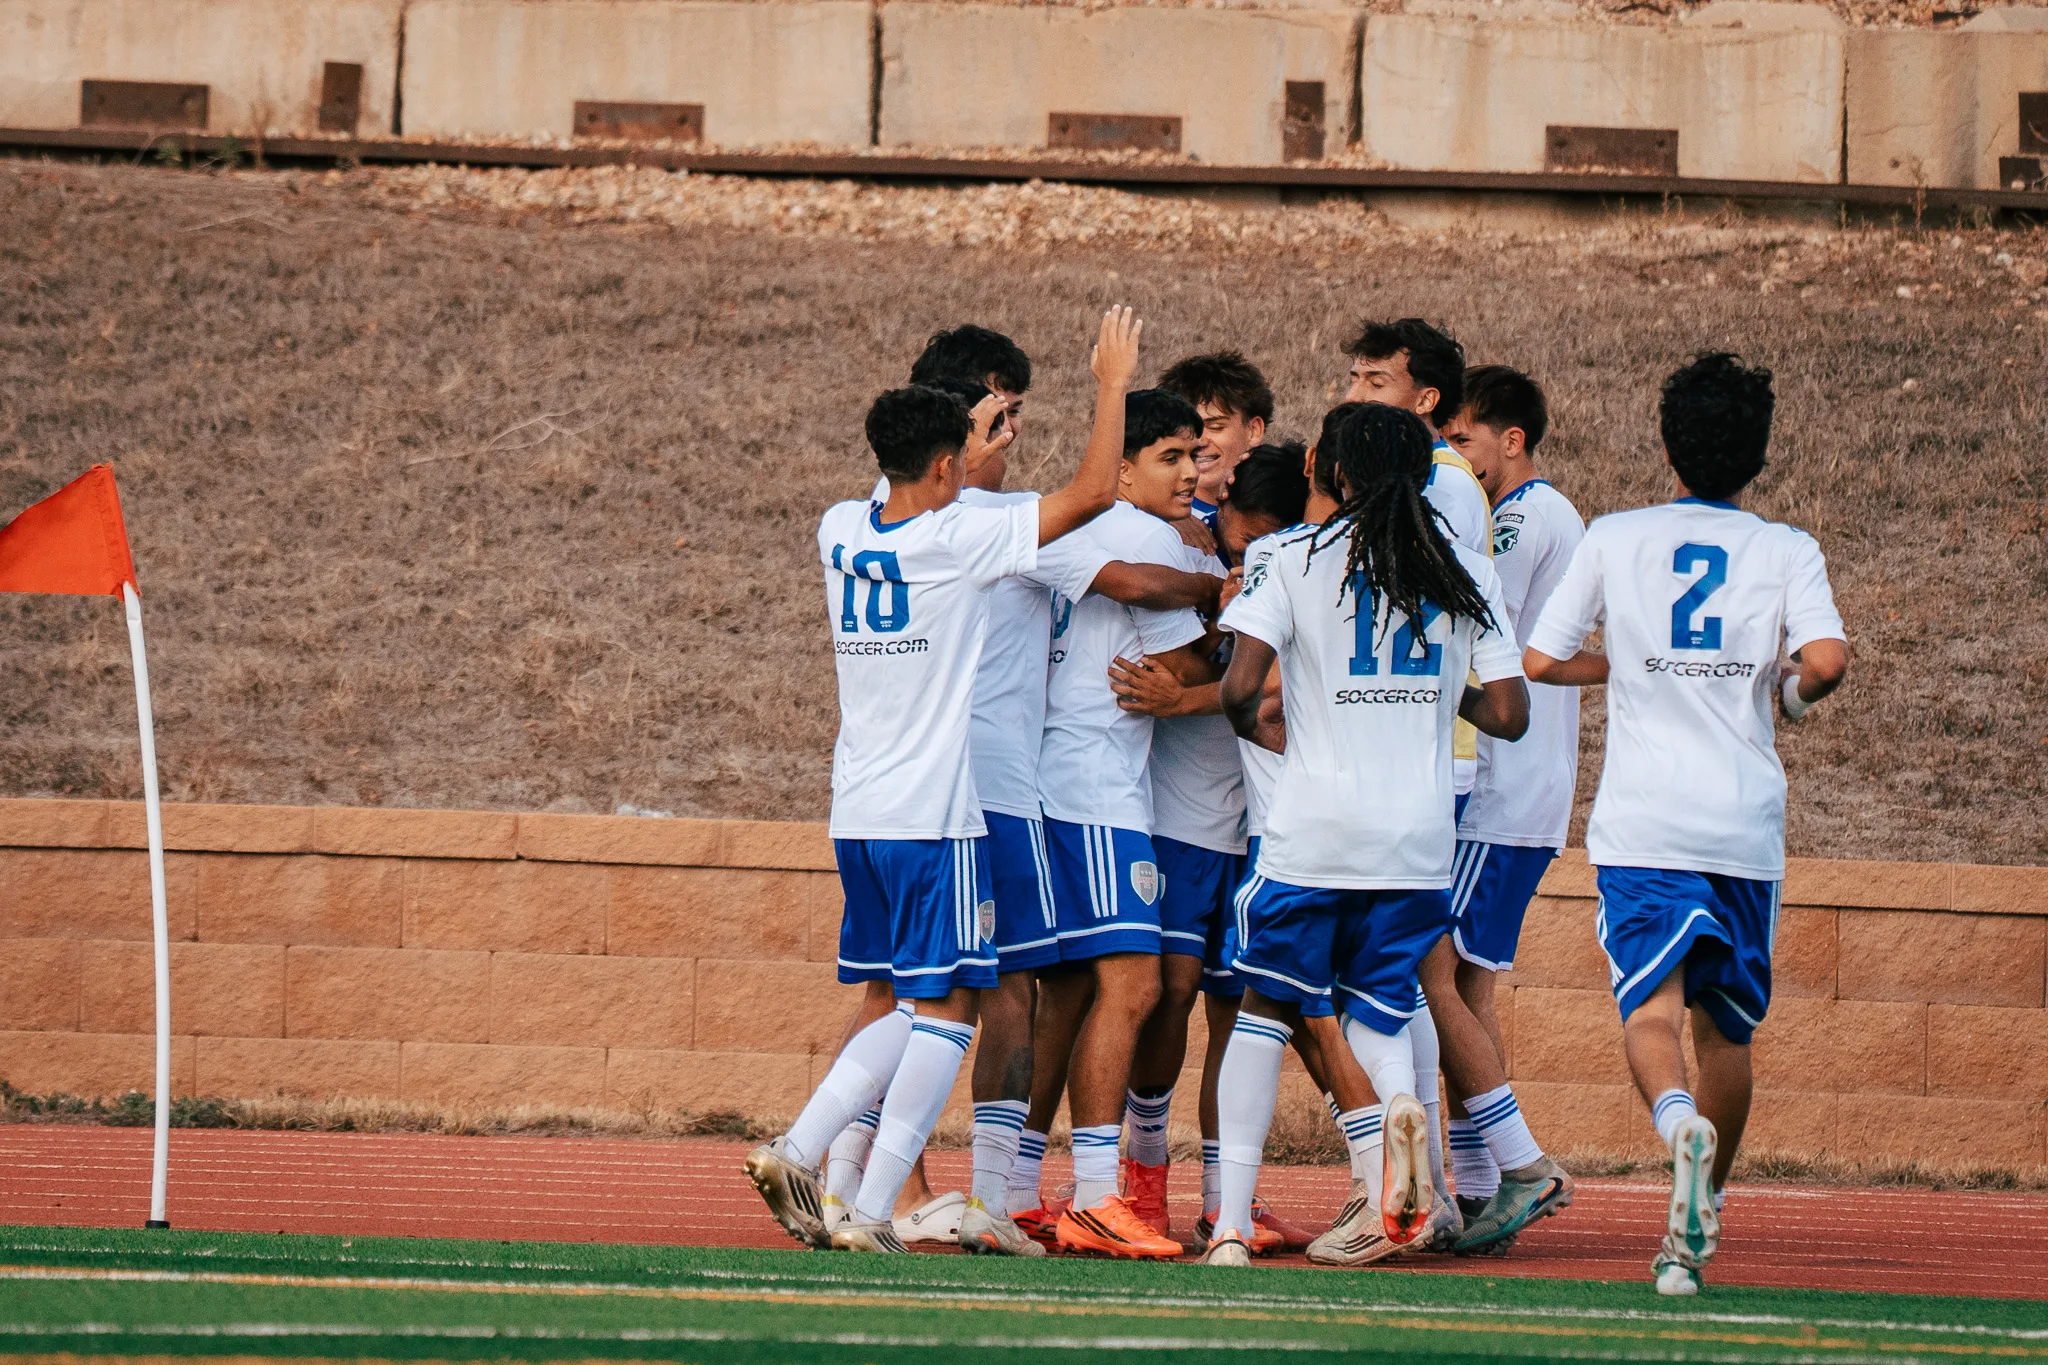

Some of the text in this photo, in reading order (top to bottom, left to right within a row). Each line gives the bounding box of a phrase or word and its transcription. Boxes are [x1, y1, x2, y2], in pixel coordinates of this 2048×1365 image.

[830, 543, 910, 633] 10
[1671, 542, 1729, 650] 2
[836, 638, 929, 656] SOCCER.COM
